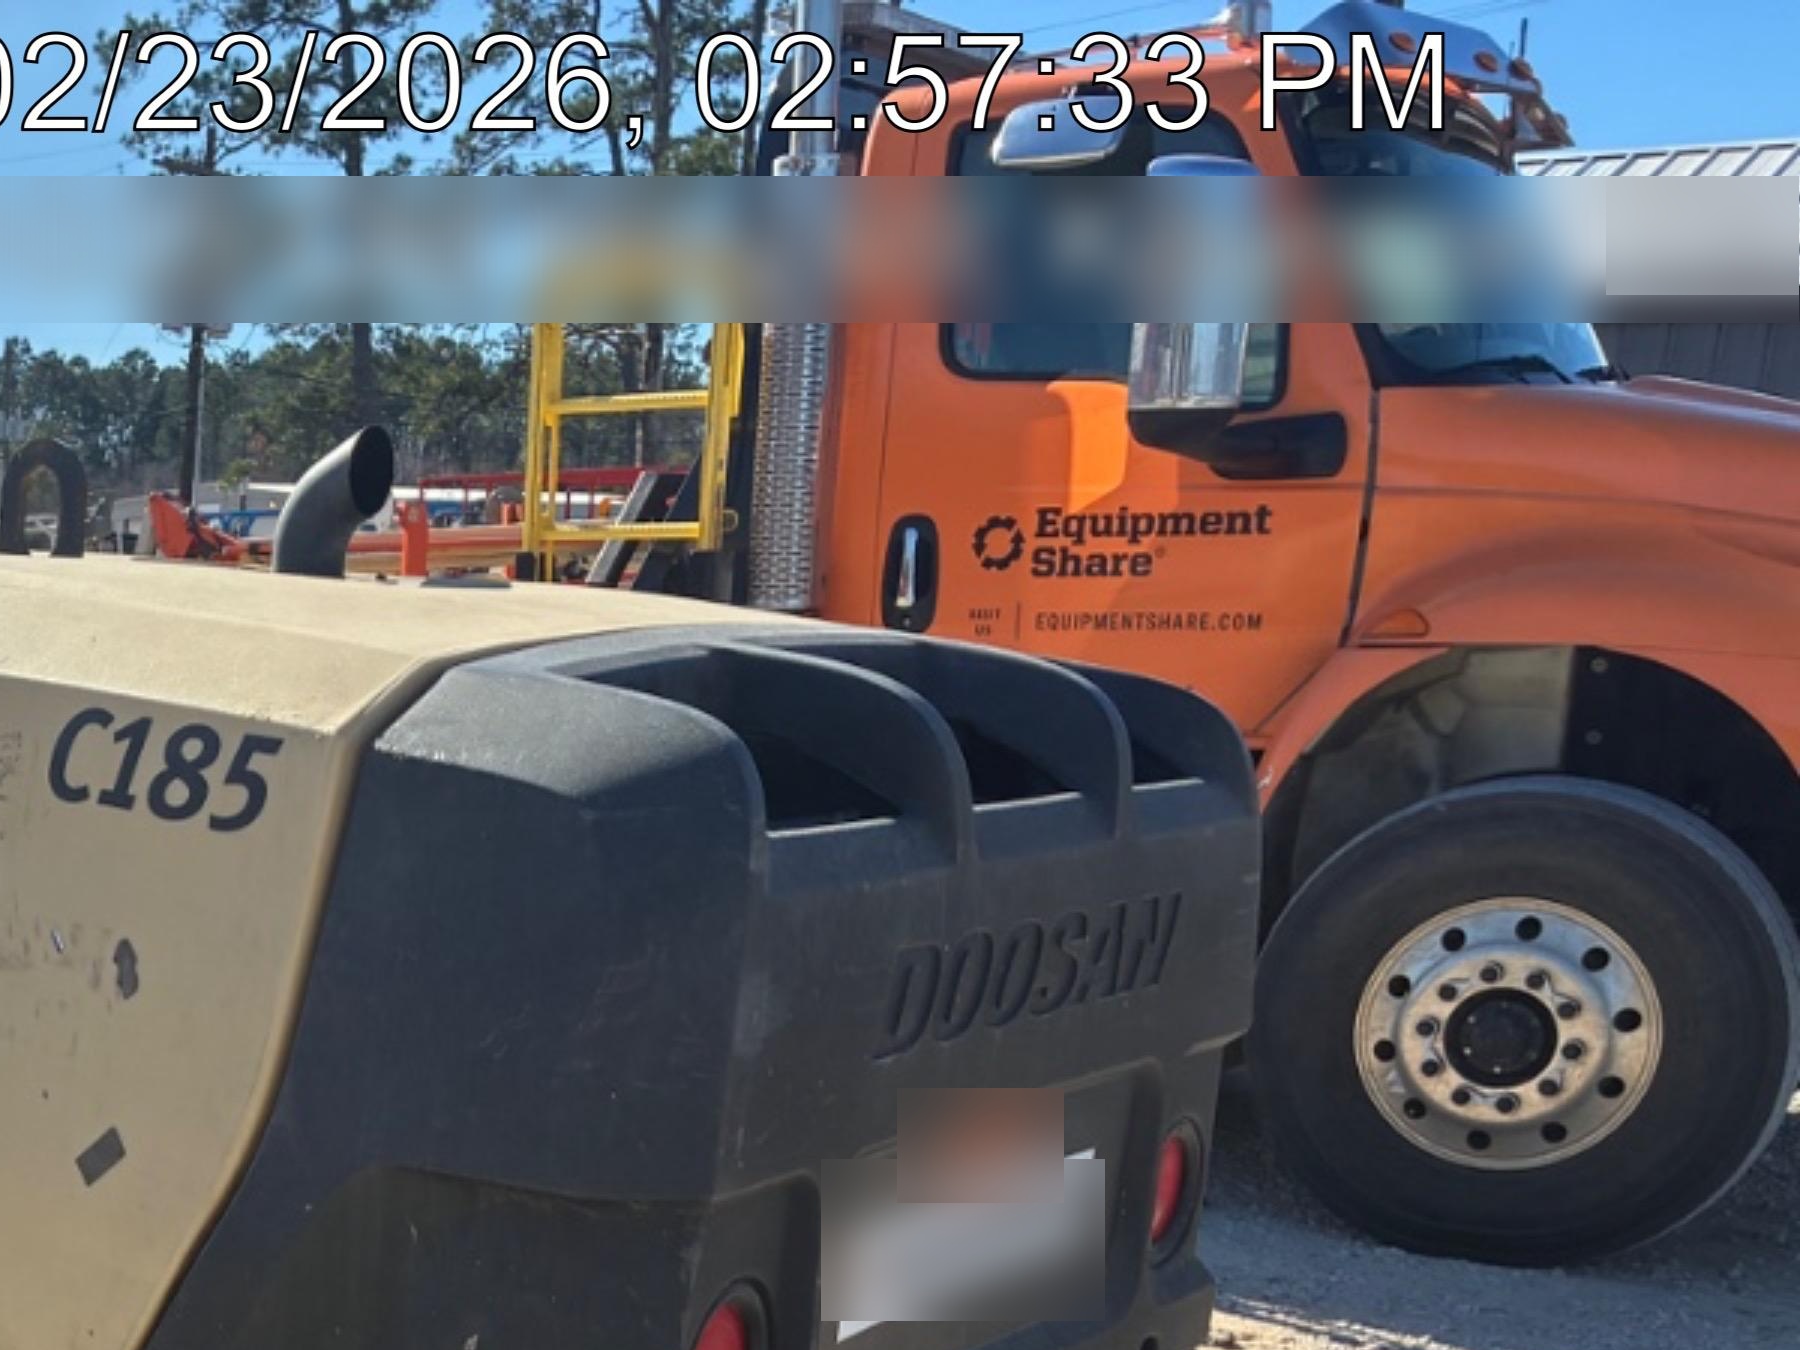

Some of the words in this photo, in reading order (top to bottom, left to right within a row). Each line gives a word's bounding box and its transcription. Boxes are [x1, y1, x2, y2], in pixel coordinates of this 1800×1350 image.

[1034, 505, 1273, 545] Equipment
[1034, 612, 1263, 632] EQUIPMENTSHARE.COM
[48, 707, 285, 832] C185
[871, 892, 1182, 1060] DOOSAN
